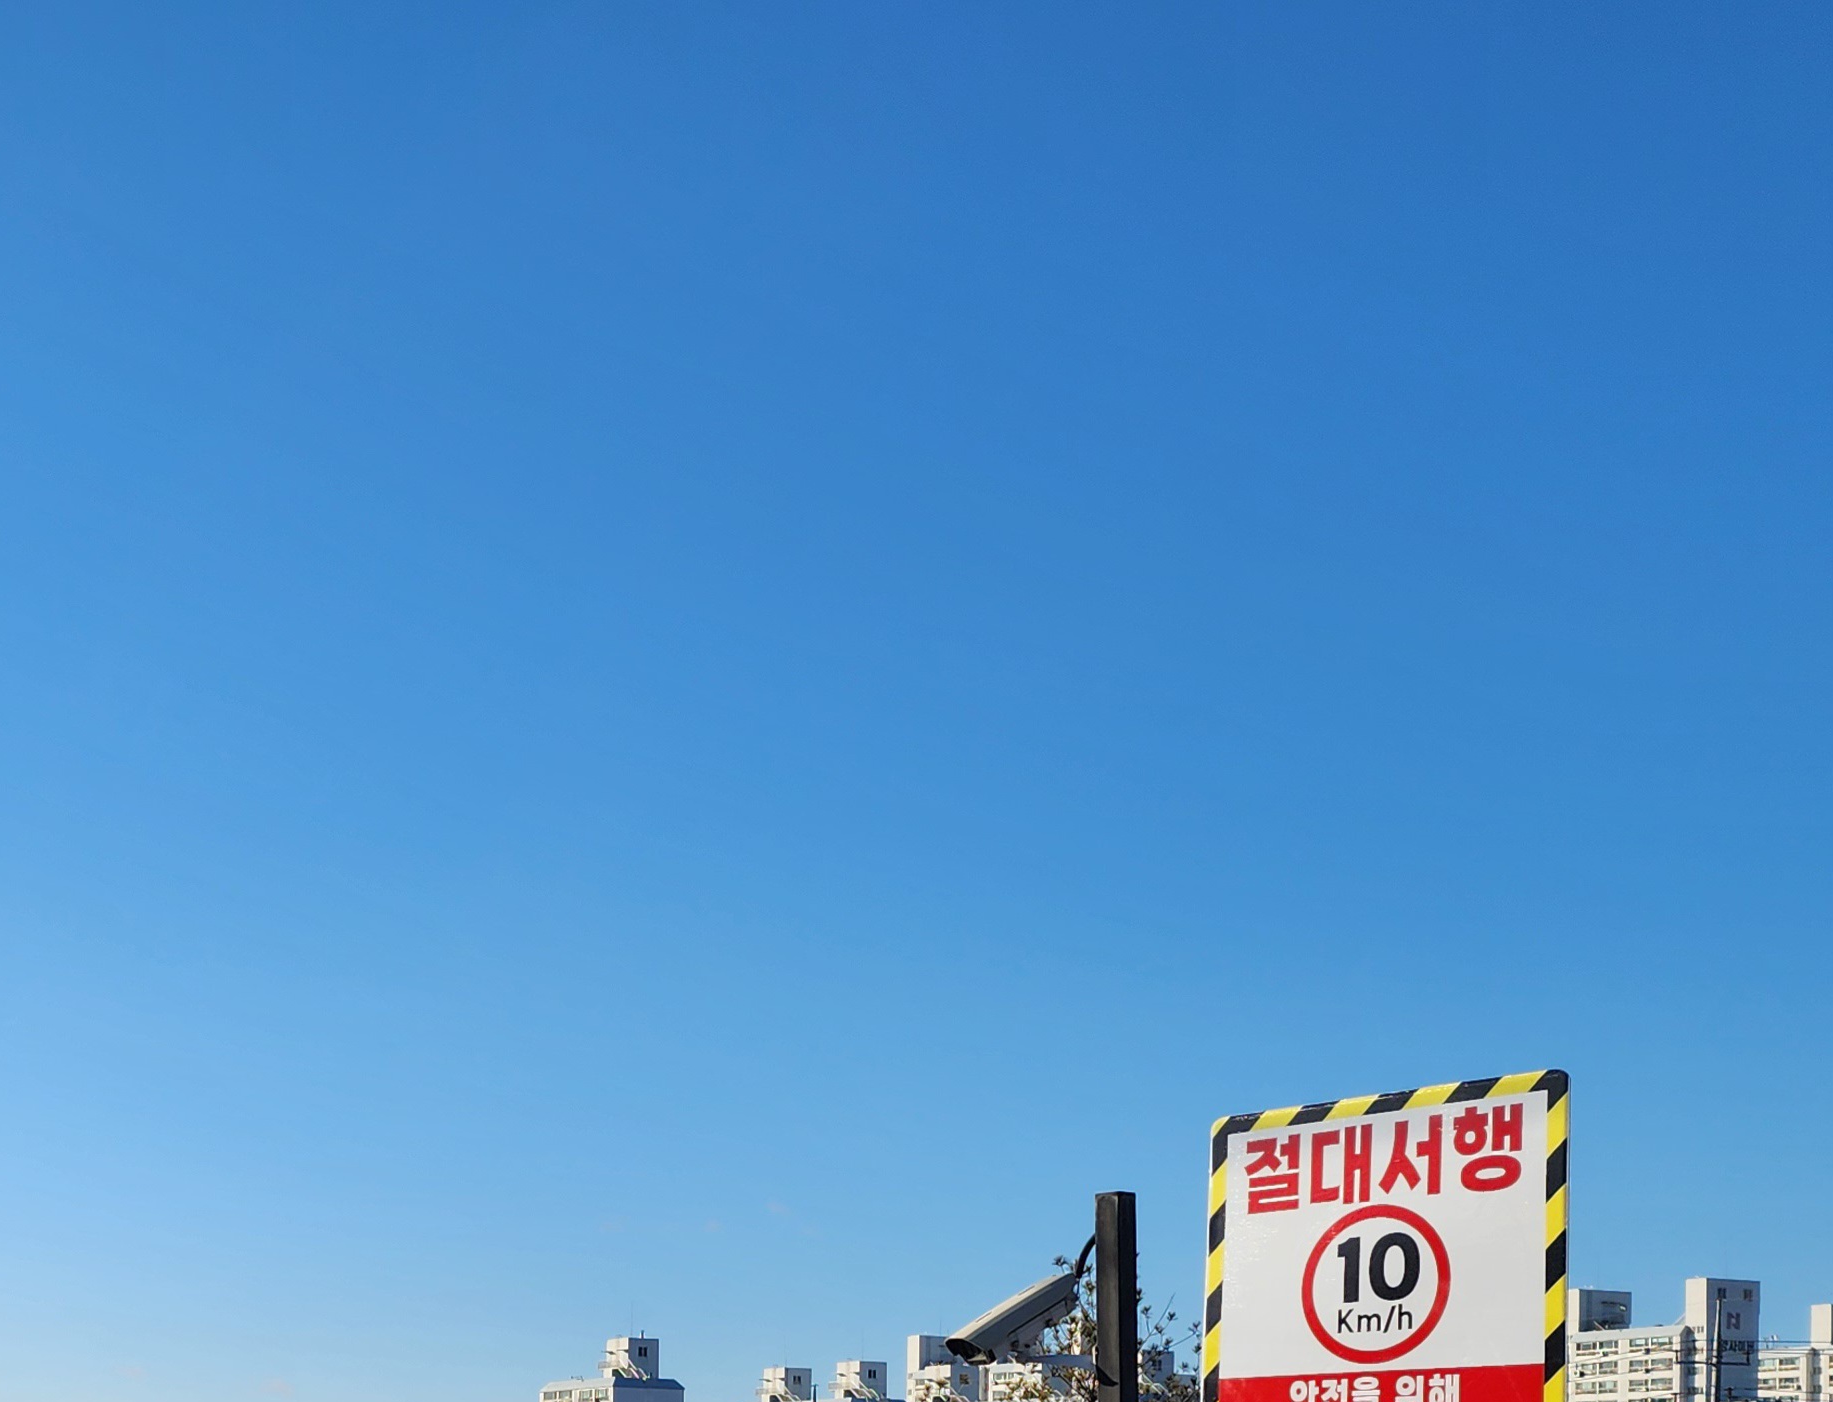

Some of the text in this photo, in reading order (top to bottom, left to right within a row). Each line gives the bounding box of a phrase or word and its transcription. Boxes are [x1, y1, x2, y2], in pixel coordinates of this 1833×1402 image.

[1243, 1102, 1525, 1216] 절대서행
[1336, 1231, 1421, 1304] 10
[1337, 1303, 1414, 1334] Km/h
